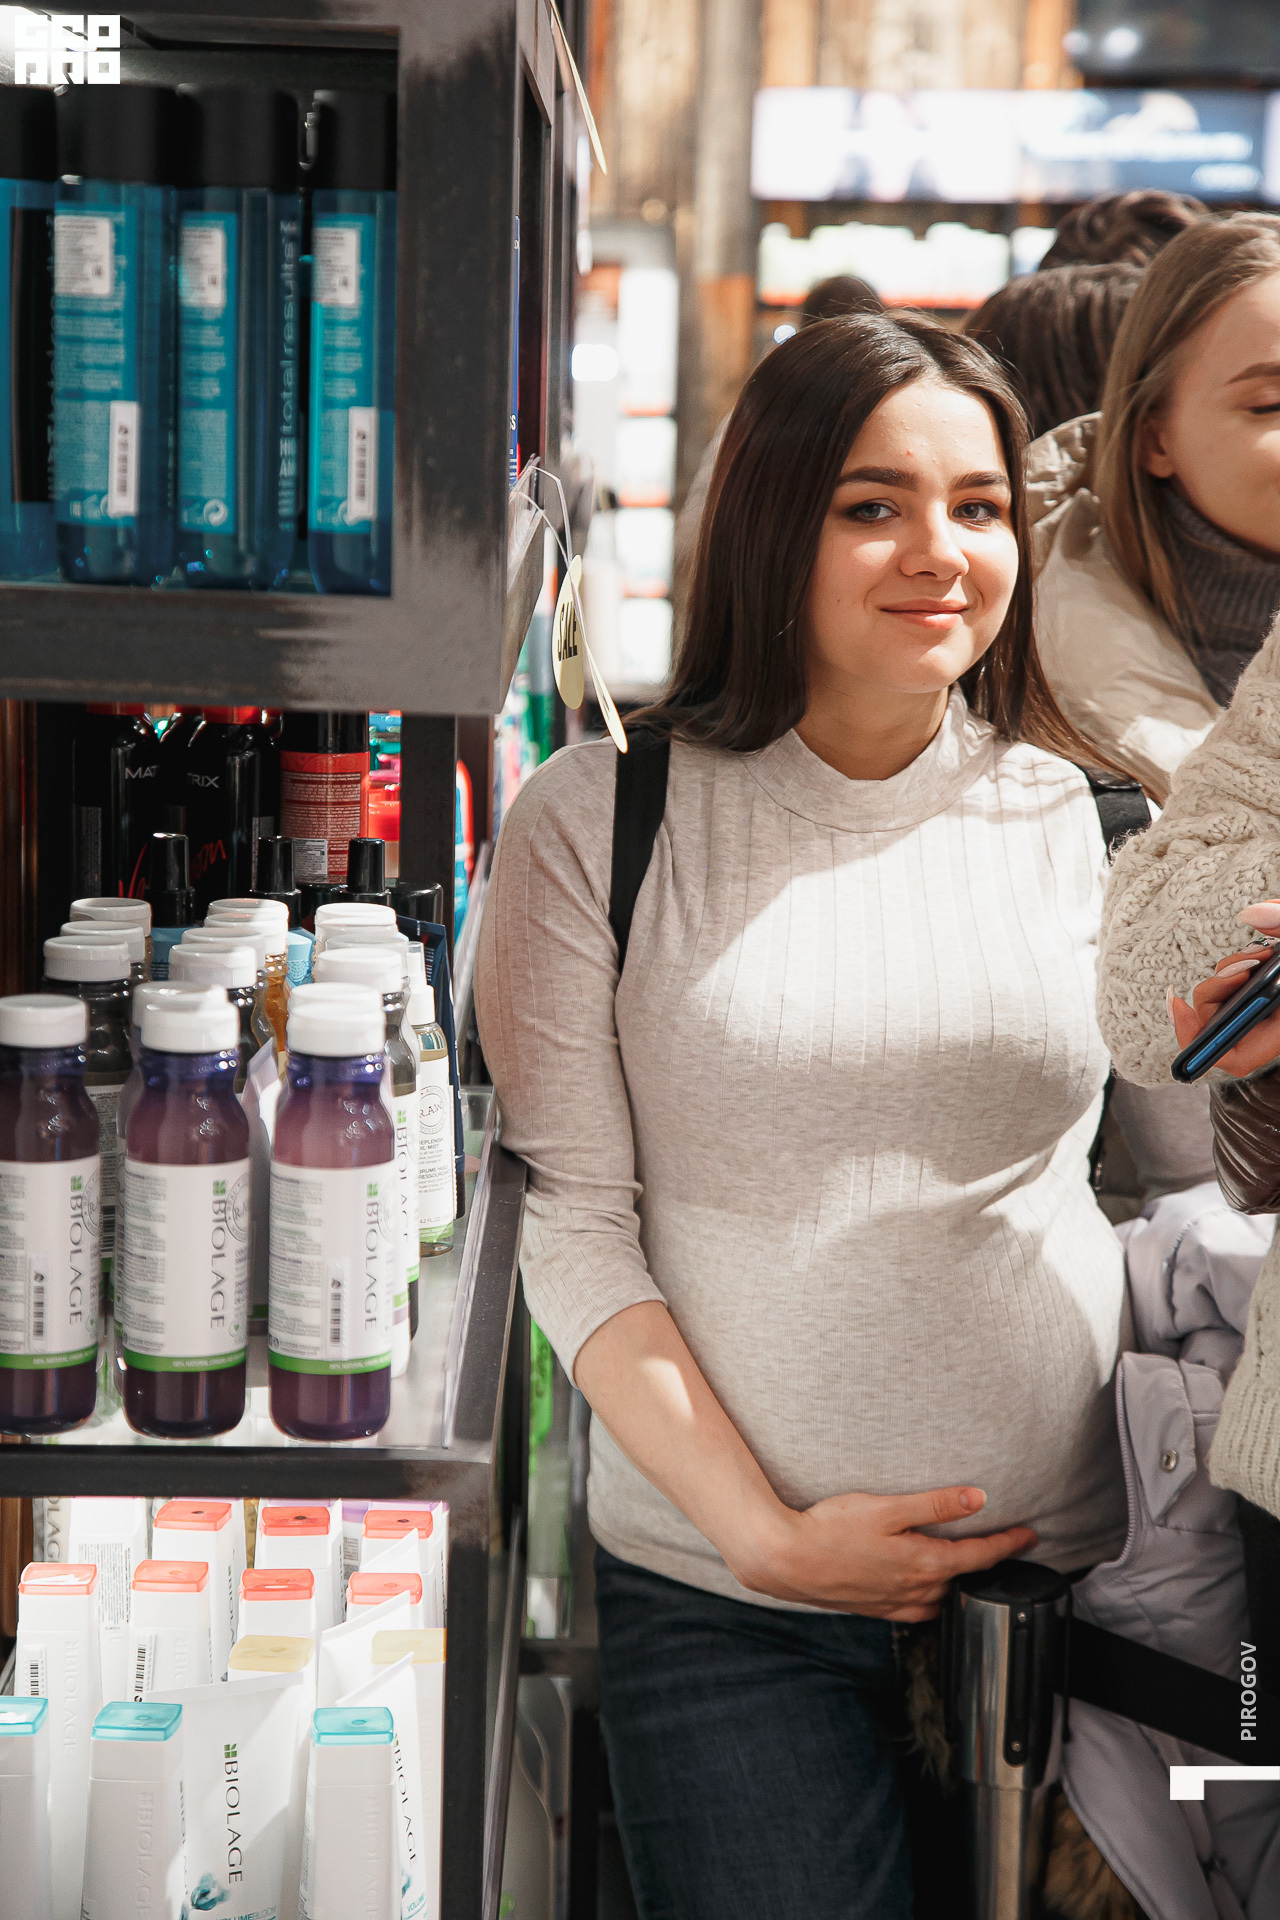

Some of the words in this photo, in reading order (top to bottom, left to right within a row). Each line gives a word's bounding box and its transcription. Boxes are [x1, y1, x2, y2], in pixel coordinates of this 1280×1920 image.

[69, 1195, 84, 1325] BIOLAGE
[210, 1200, 226, 1329] BIOLAGE
[364, 1202, 379, 1331] BIOLAGE
[224, 1761, 242, 1883] BIOLAGE
[394, 1748, 417, 1868] BIOLAGE
